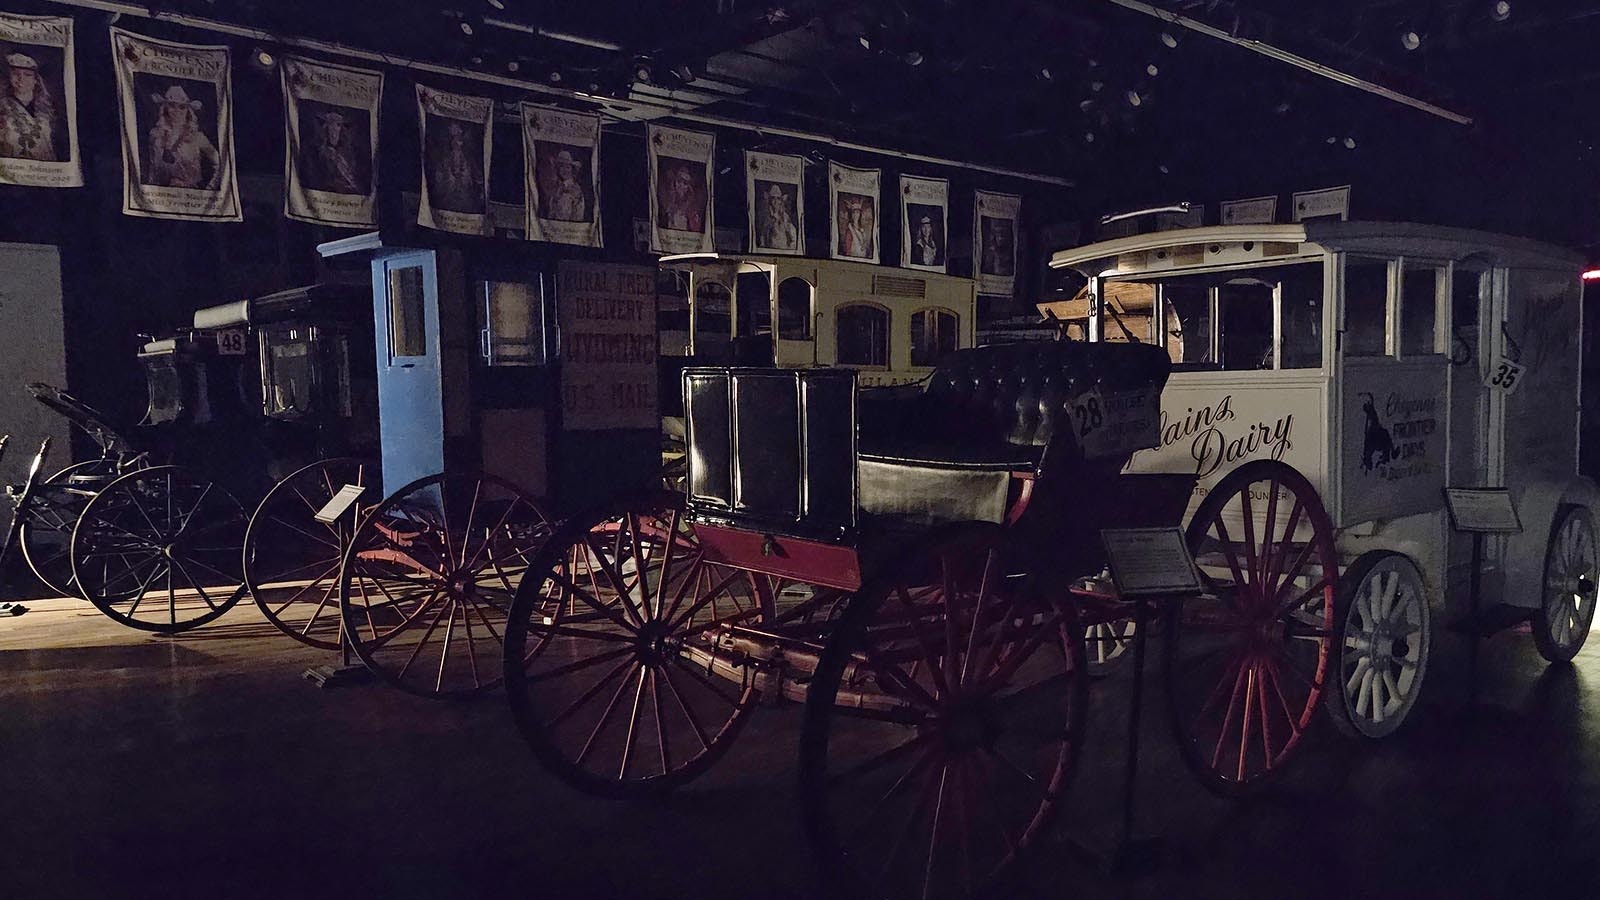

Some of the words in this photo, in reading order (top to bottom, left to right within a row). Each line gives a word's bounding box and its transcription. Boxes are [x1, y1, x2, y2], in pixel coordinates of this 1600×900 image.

[143, 46, 221, 70] CHEYENNE
[564, 270, 610, 292] RURAL
[616, 272, 655, 295] FREE
[575, 297, 644, 321] DELIVERY
[222, 333, 242, 351] 48
[567, 333, 655, 365] WYOMING
[1492, 364, 1519, 389] 35
[611, 382, 655, 409] MAIL
[1076, 397, 1102, 438] 28
[1152, 395, 1235, 452] lains
[1191, 414, 1292, 478] Dairy
